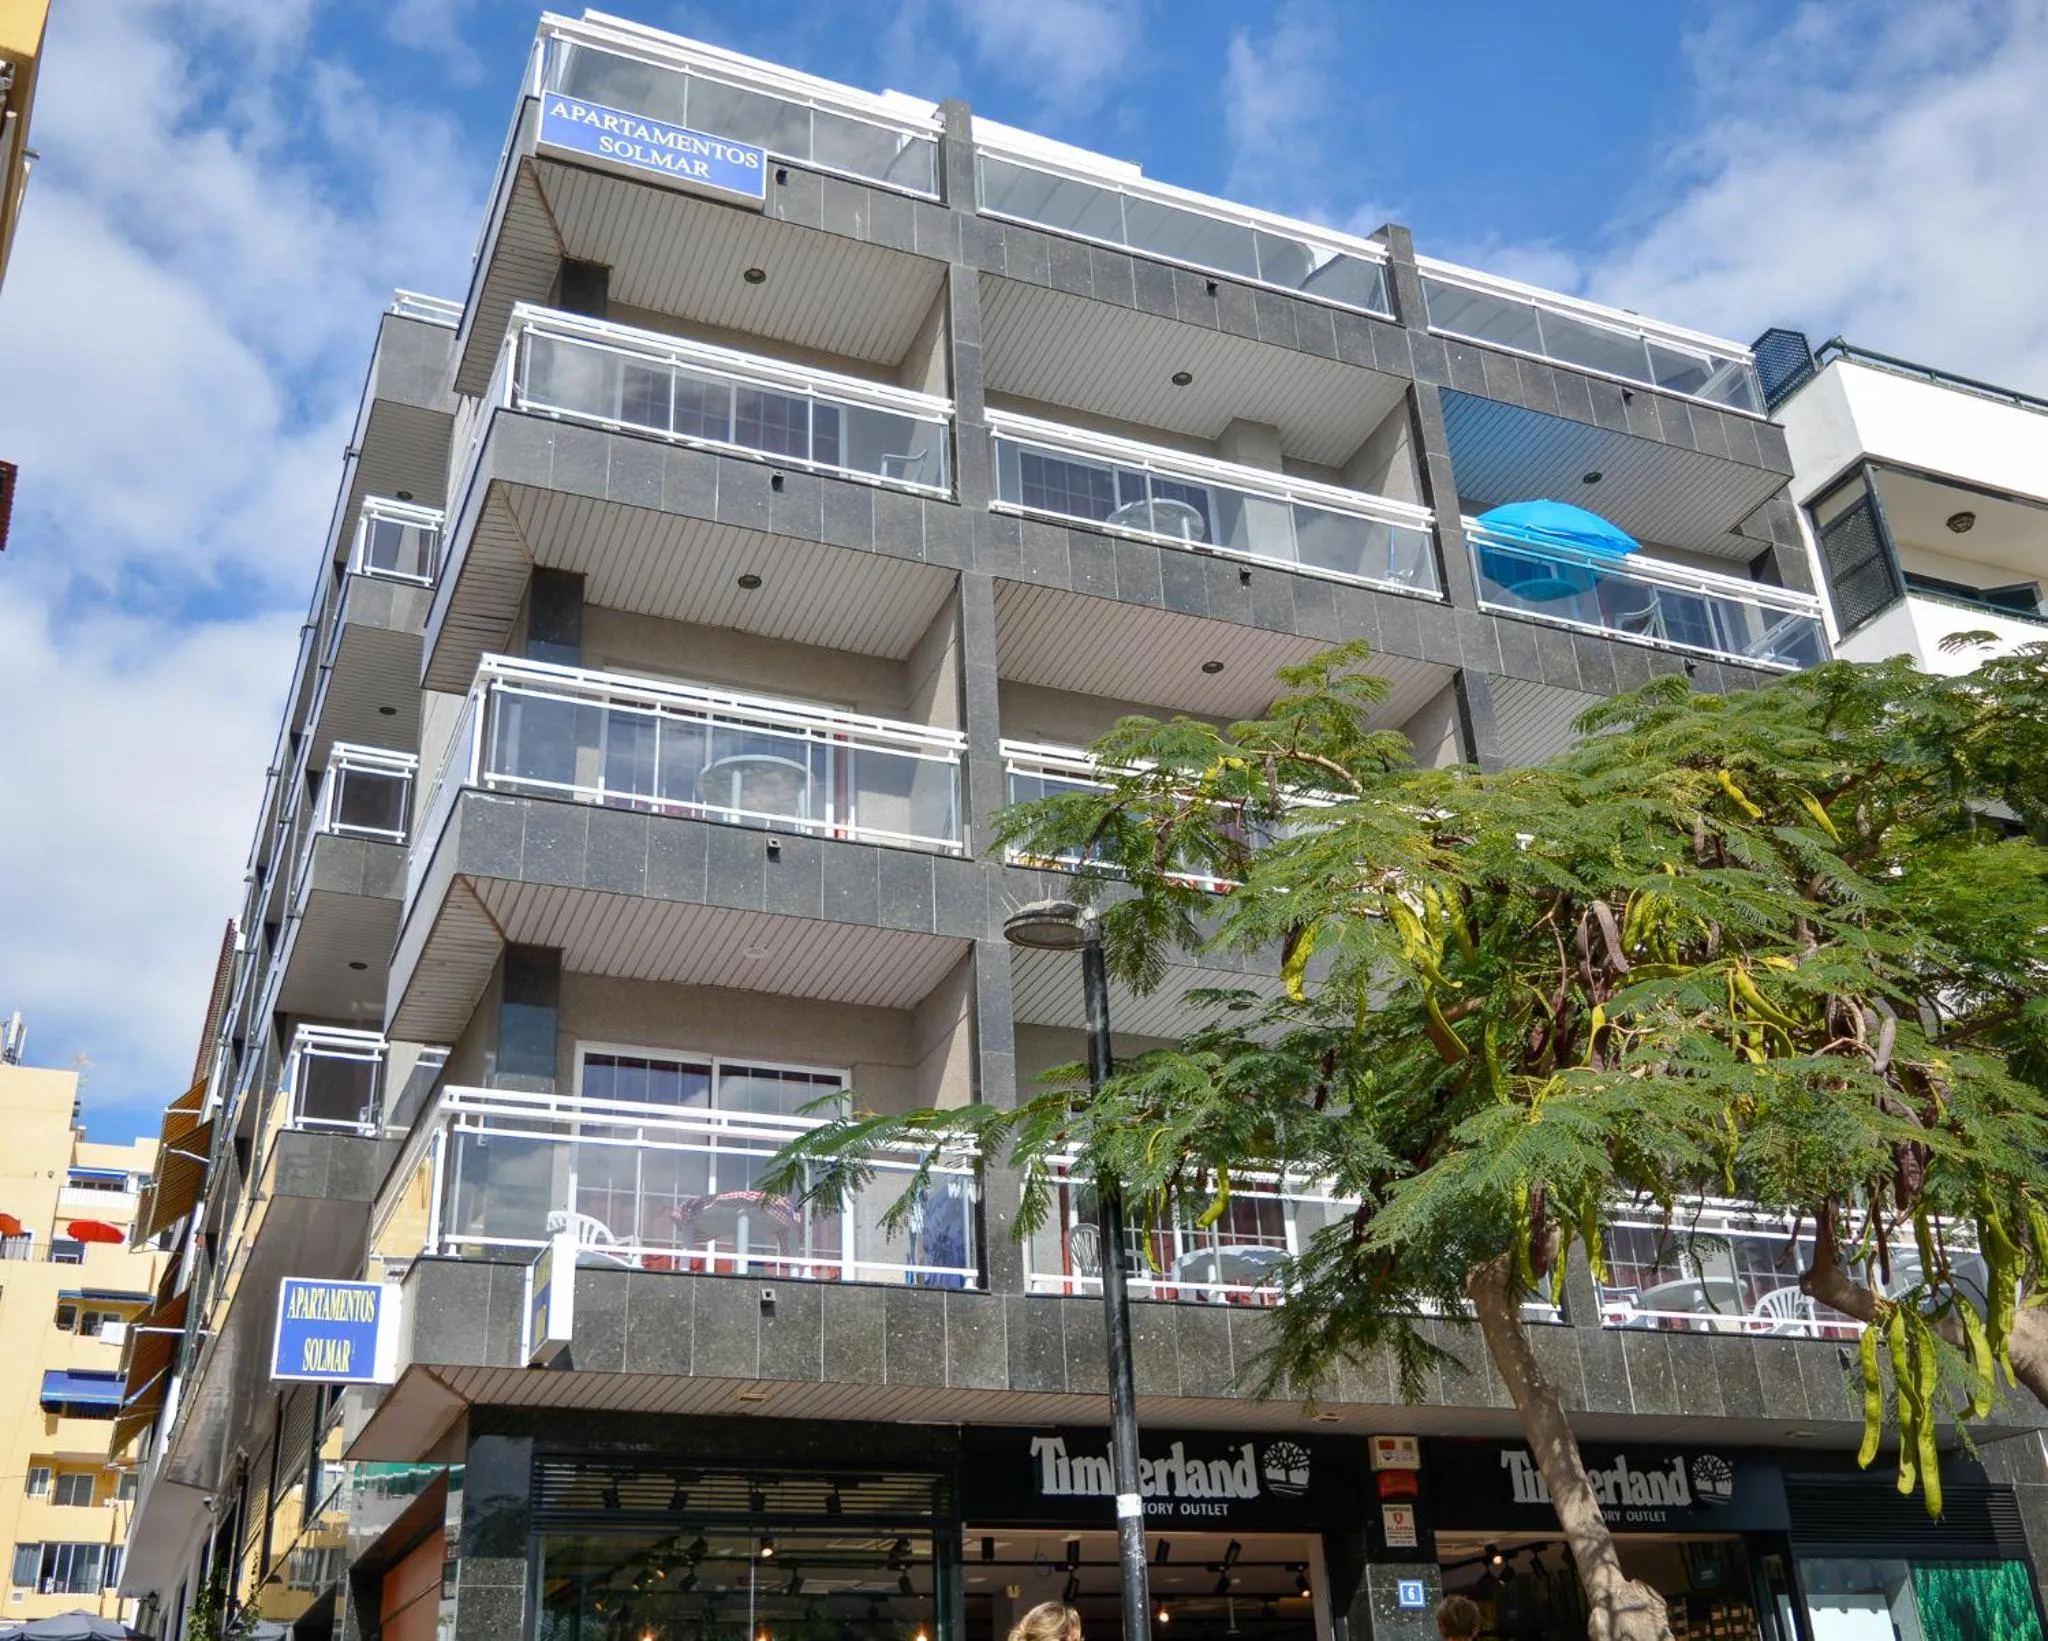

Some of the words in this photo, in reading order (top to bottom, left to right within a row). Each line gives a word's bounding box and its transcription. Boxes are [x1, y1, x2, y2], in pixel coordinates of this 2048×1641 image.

[549, 102, 760, 170] APARTAMENTOS
[599, 137, 711, 179] SOLMAR
[287, 1286, 376, 1323] APARTAMENTOS
[302, 1338, 351, 1372] SOLMAR
[1030, 1437, 1261, 1498] Timerland
[1180, 1503, 1229, 1517] OUTLET
[1626, 1510, 1667, 1522] OUTLET
[1407, 1586, 1416, 1601] 6
